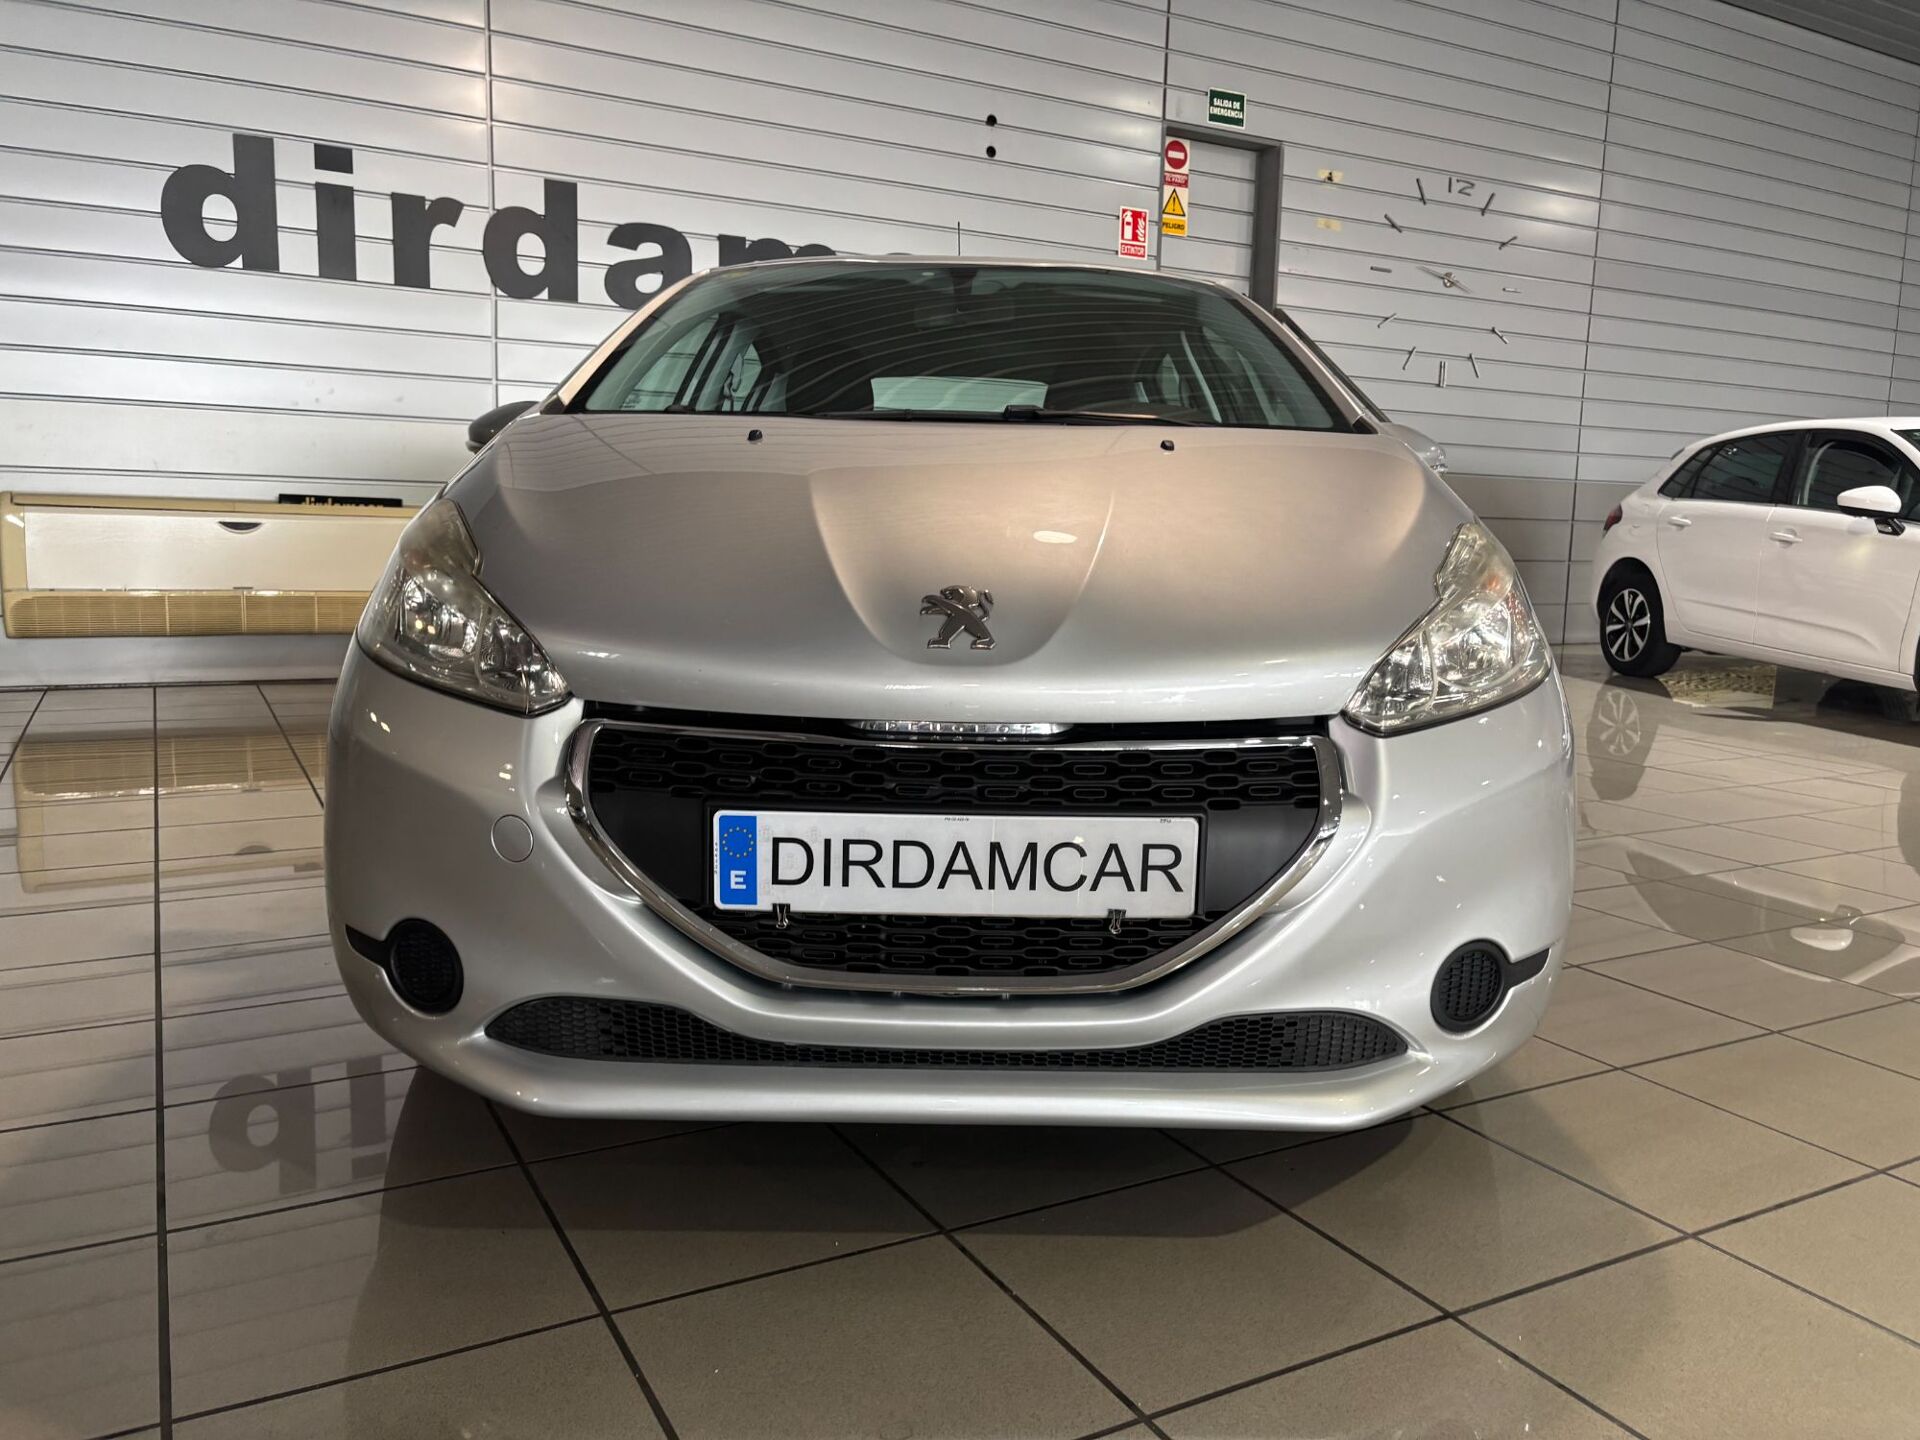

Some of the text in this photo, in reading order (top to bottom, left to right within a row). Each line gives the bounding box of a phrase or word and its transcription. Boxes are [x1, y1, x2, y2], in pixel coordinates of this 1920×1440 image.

[1213, 97, 1240, 110] SALIDA DE
[1210, 106, 1243, 118] EMERGENCIA
[1448, 176, 1475, 197] 12
[1162, 222, 1185, 230] PELIGRO
[1121, 245, 1145, 256] EXTINTOR
[771, 836, 1184, 893] DIRDAMCAR
[730, 870, 747, 890] E
